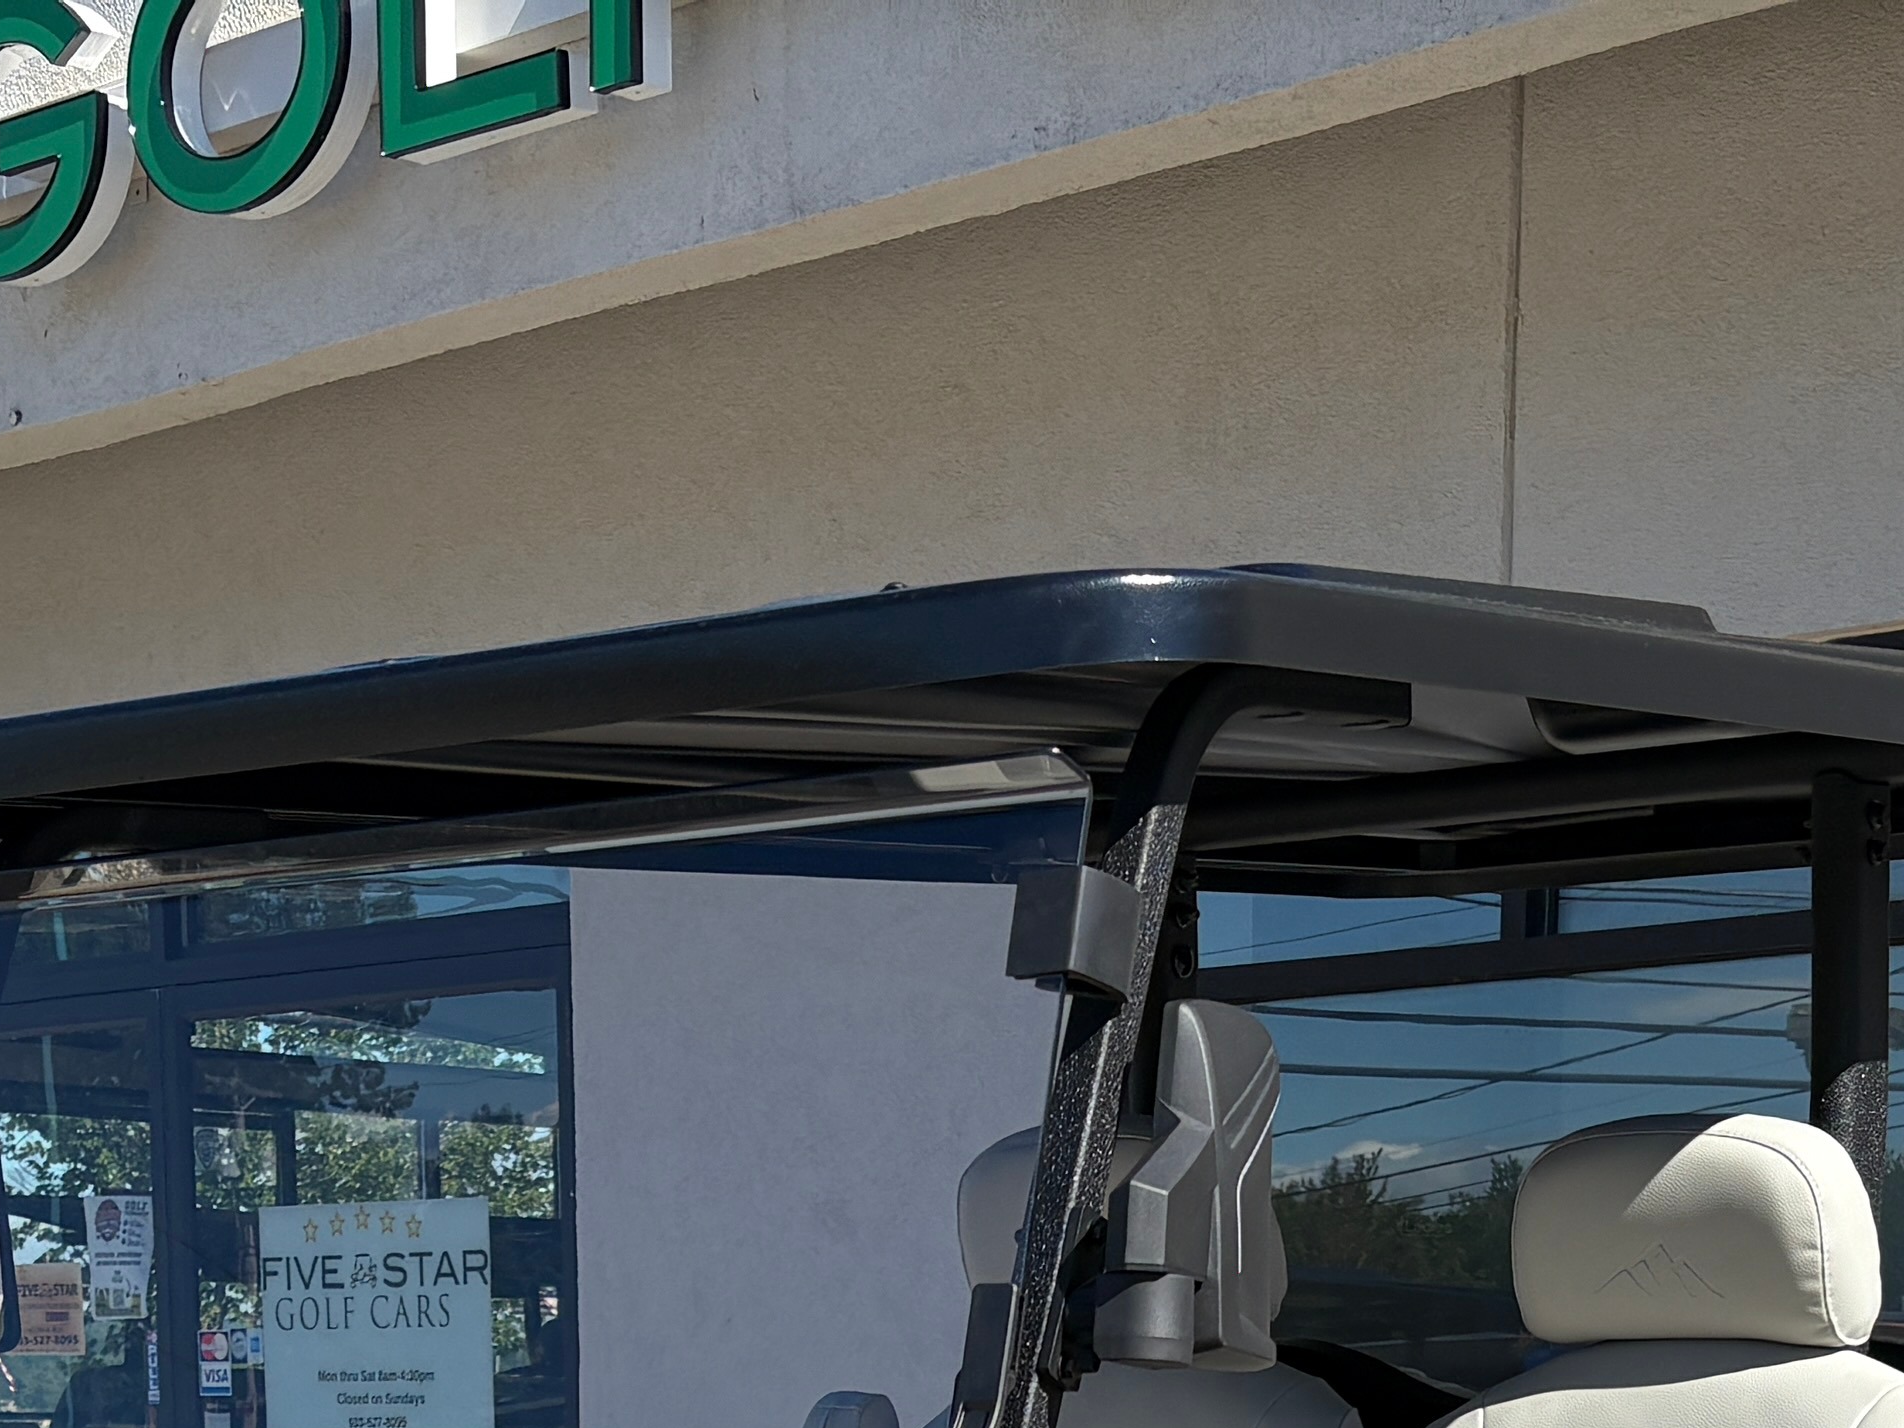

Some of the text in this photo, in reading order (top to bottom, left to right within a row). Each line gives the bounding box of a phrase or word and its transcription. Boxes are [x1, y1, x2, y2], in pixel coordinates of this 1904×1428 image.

[261, 1249, 489, 1291] FIVE STAR
[52, 1283, 79, 1296] STAR
[275, 1293, 451, 1331] GOLF CARS
[204, 1368, 229, 1383] VISA
[317, 1370, 338, 1382] Mon
[360, 1370, 376, 1382] Sat
[336, 1392, 426, 1407] Closed on Sundays
